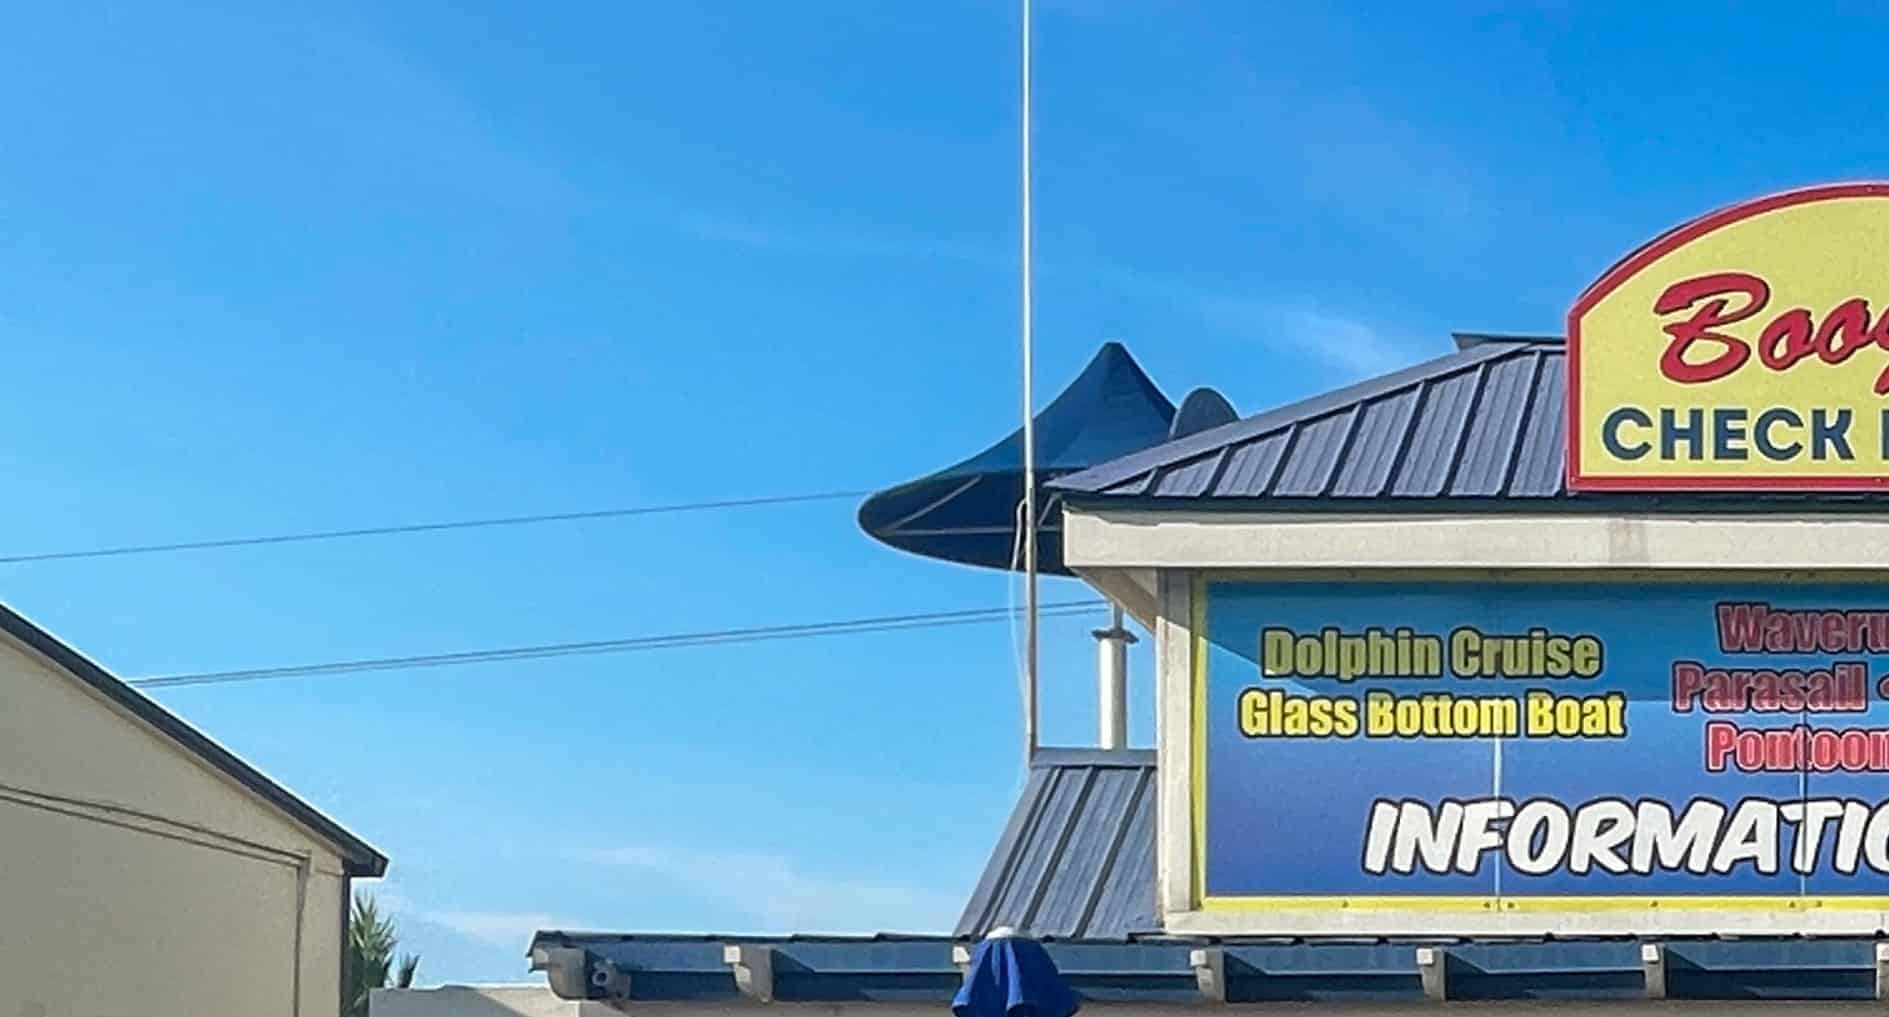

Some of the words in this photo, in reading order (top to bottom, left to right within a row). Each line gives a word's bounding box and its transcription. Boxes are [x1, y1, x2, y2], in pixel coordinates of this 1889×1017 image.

[1602, 408, 1856, 461] CHECK
[1262, 628, 1443, 679] Dolphin
[1451, 629, 1602, 677] Cruise
[1674, 663, 1867, 712] Parasail
[1239, 692, 1361, 737] Glass
[1367, 692, 1518, 737] Bottom
[1526, 692, 1626, 737] Boat
